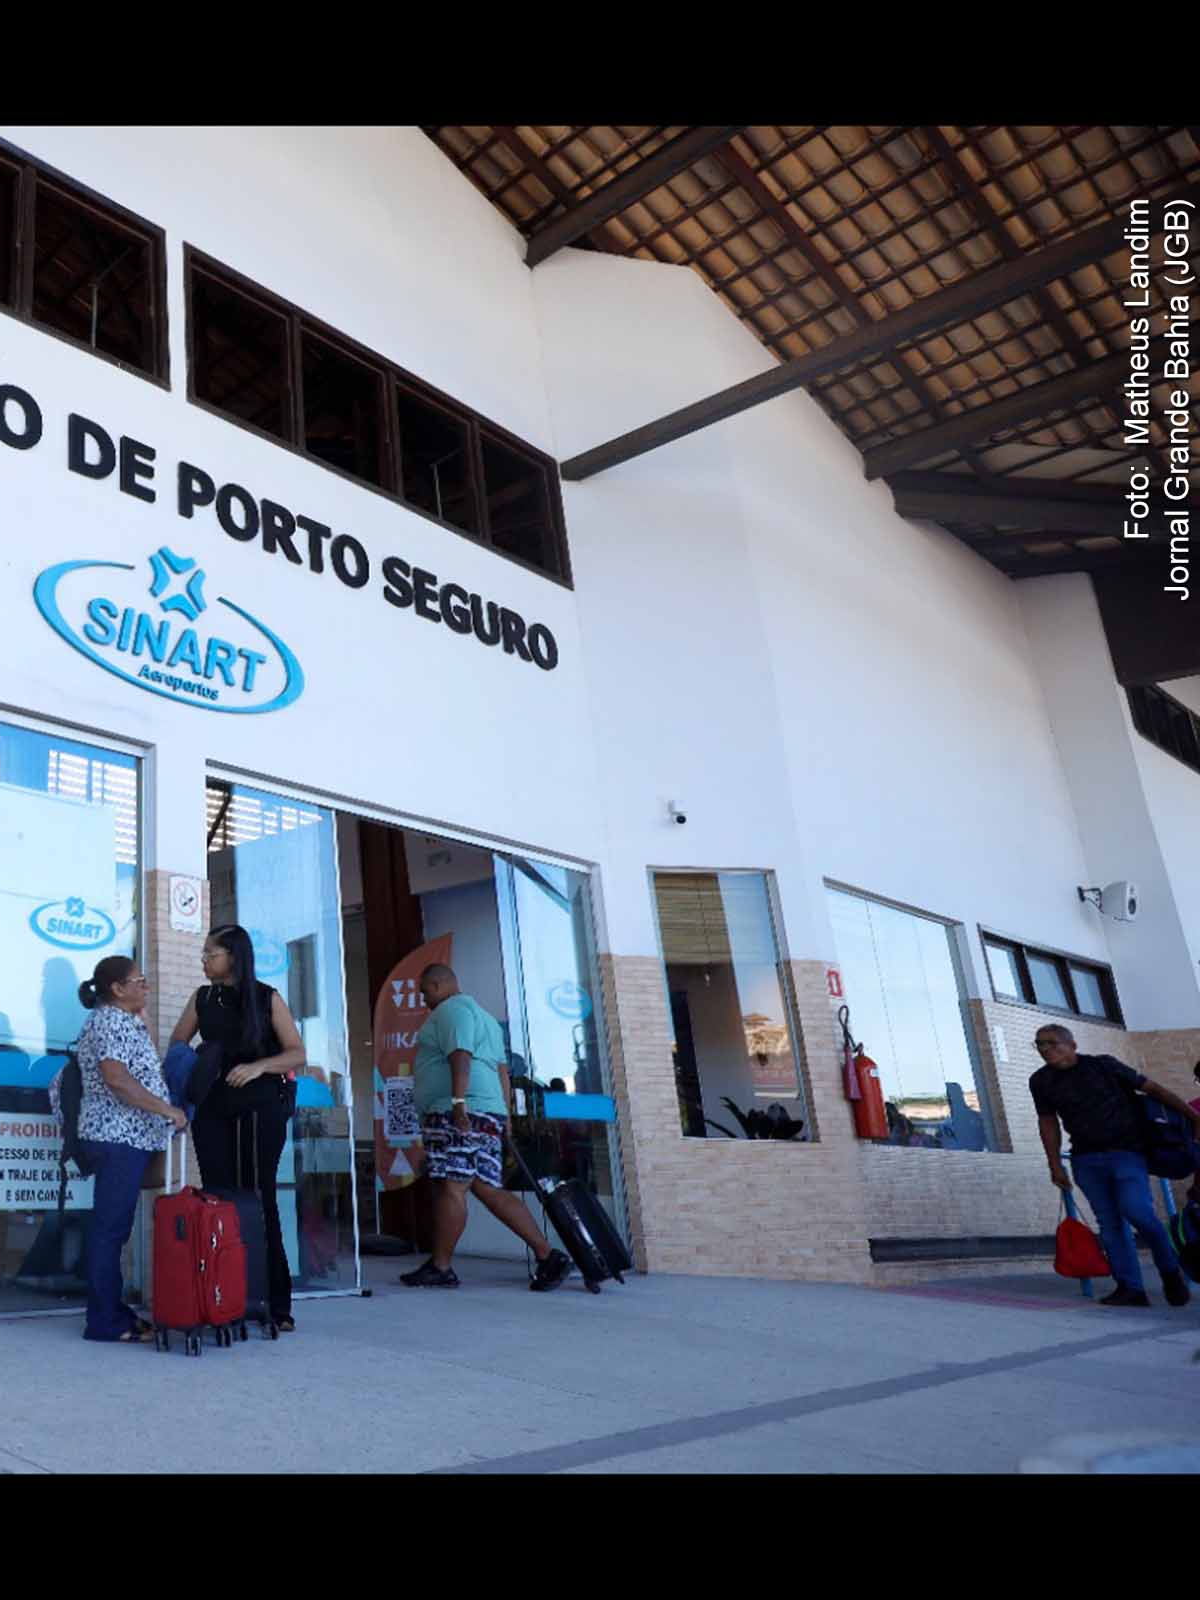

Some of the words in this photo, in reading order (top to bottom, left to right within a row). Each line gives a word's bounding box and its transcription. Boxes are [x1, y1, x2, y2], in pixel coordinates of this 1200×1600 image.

[68, 412, 157, 504] DE
[177, 461, 370, 589] PORTO
[381, 556, 560, 671] SEGURO
[82, 597, 267, 693] SINART
[137, 664, 219, 701] Aeroportos
[47, 917, 105, 940] SINART
[0, 1122, 62, 1138] PROIBI
[32, 1148, 45, 1161] DE
[47, 1148, 61, 1161] PE
[8, 1168, 39, 1182] TRAJE
[41, 1168, 55, 1182] DE
[14, 1188, 35, 1202] SEM
